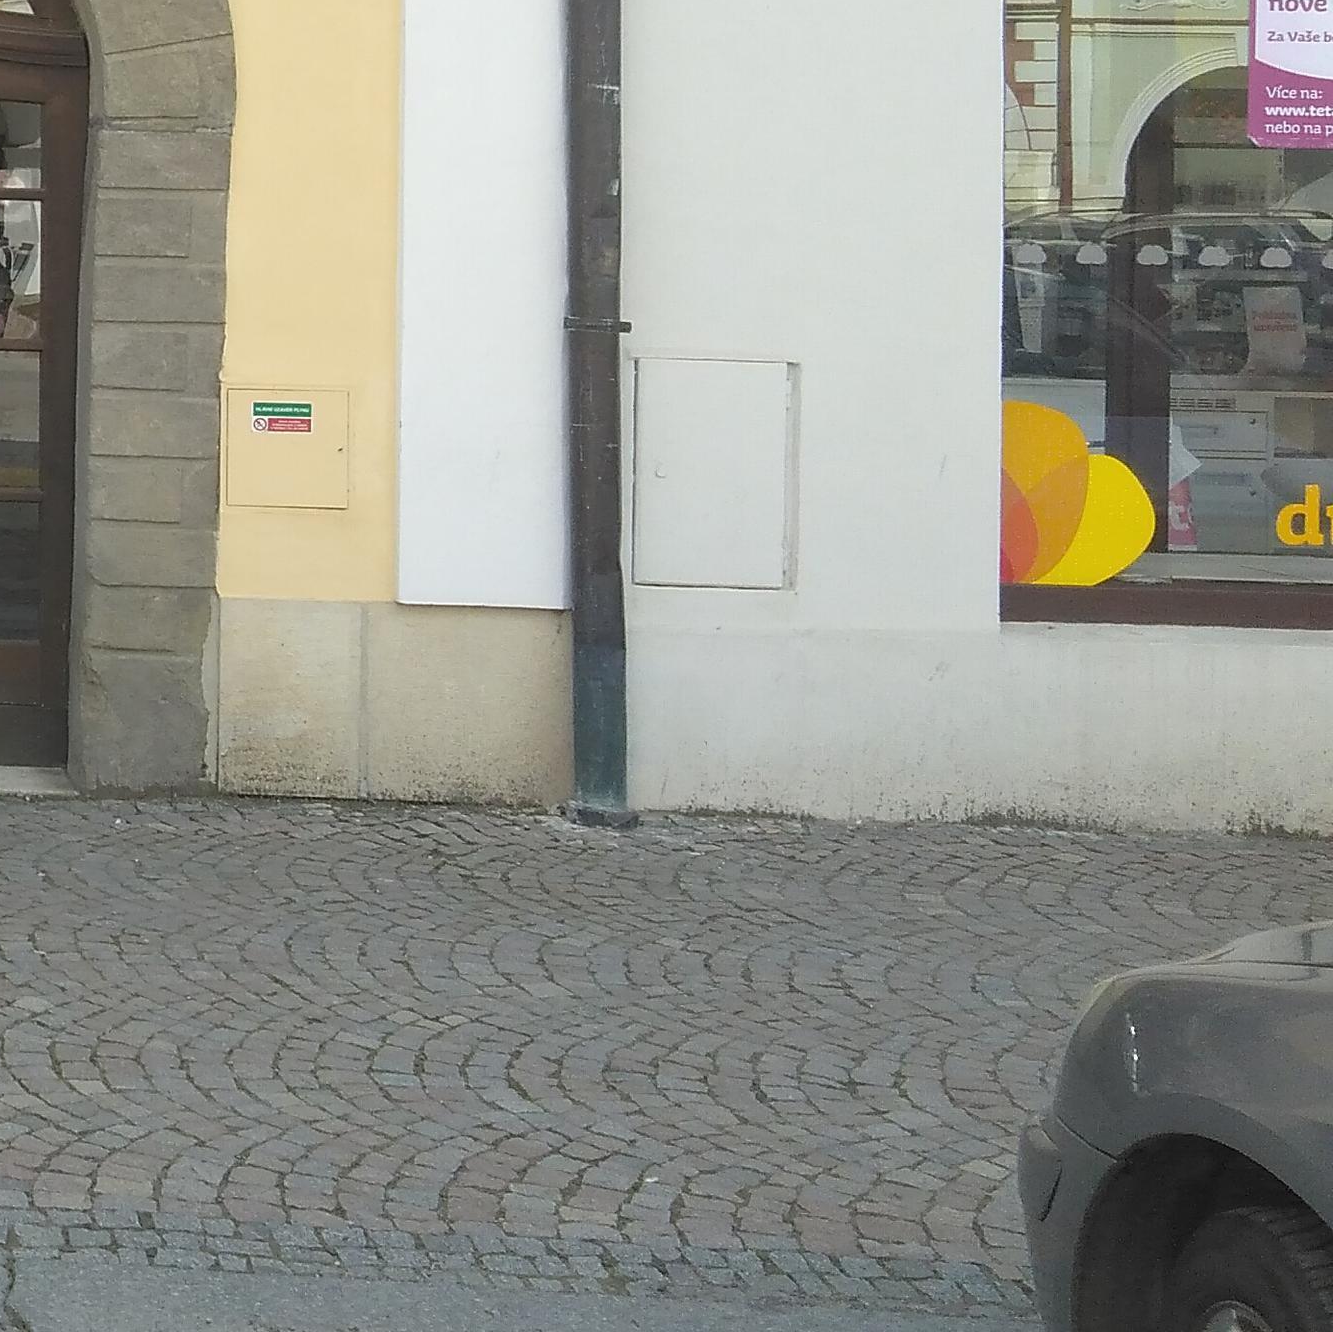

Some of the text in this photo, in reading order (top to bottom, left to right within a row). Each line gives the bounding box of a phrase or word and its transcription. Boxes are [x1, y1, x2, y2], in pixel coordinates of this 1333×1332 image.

[1267, 30, 1284, 42] Za
[1287, 30, 1321, 43] Vaše
[1265, 85, 1324, 99] Více na:
[1264, 120, 1300, 134] nebo
[1303, 124, 1321, 134] na
